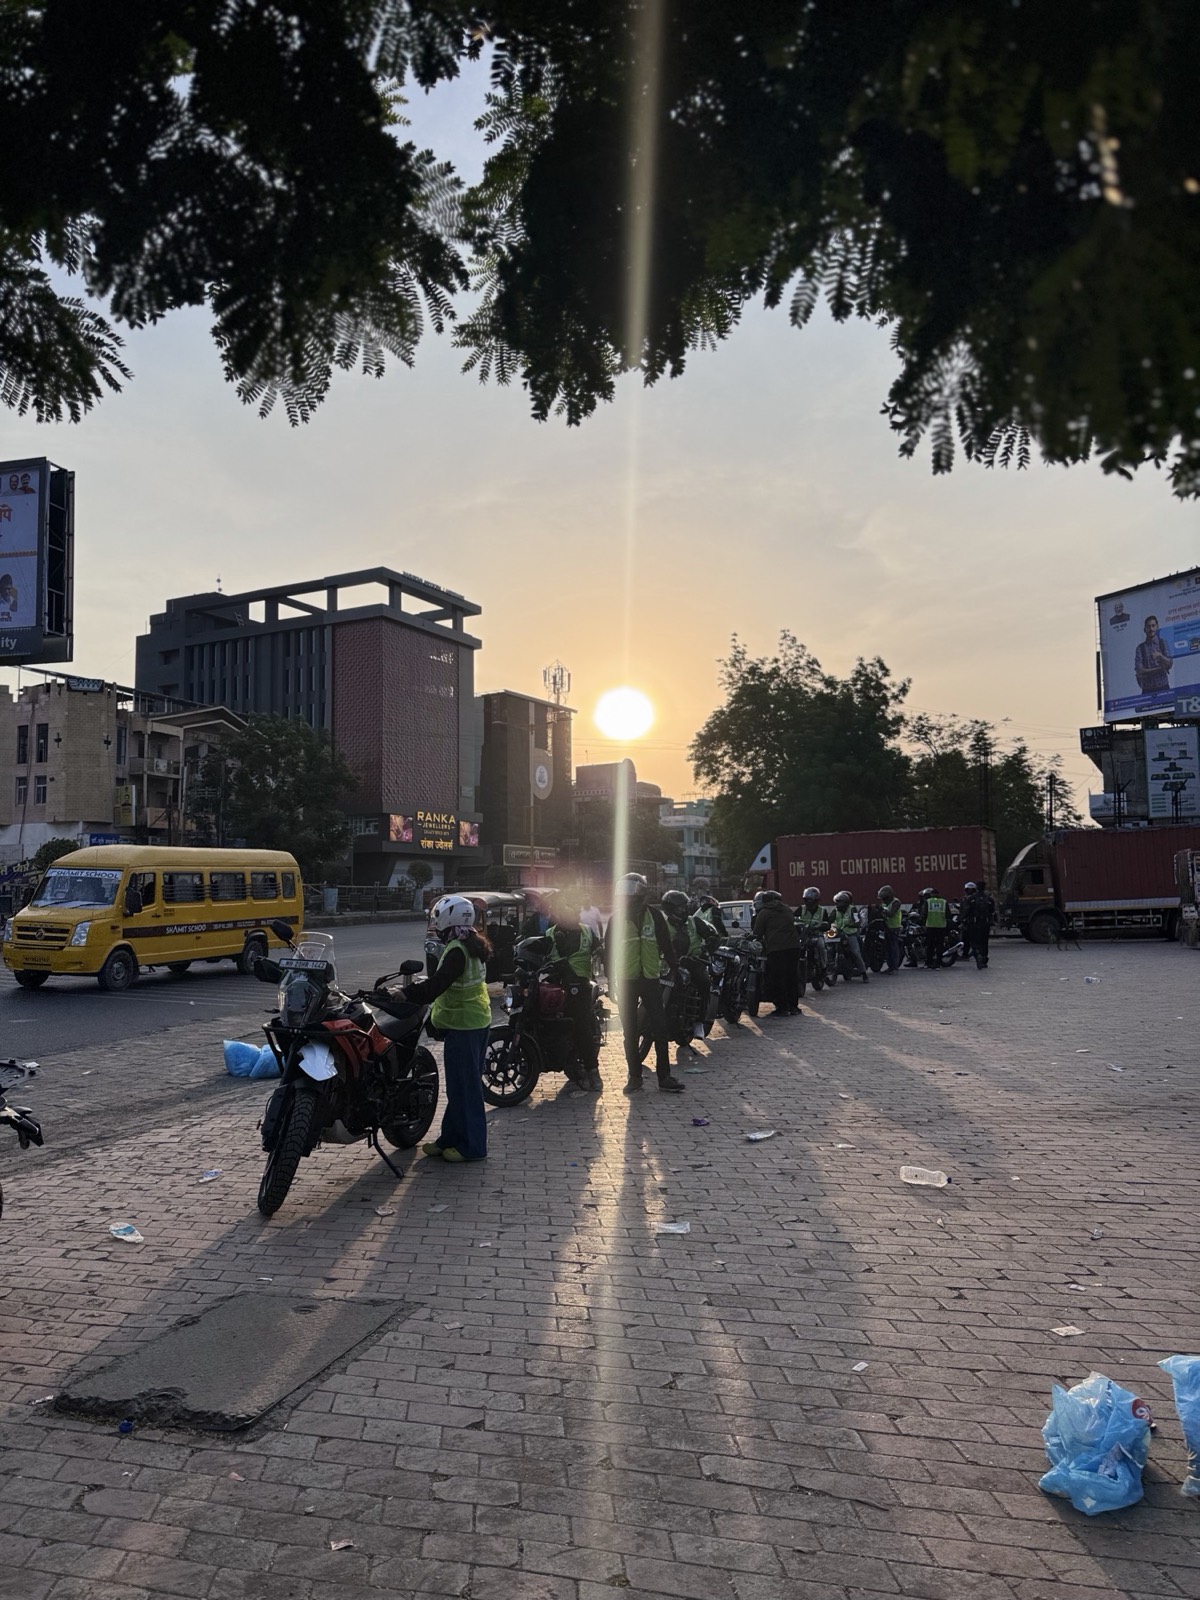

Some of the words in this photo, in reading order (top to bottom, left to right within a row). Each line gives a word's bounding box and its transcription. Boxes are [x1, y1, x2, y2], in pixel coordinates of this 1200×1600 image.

[417, 811, 456, 824] RANKA
[789, 861, 805, 877] OM
[811, 860, 829, 876] SAI
[840, 856, 906, 876] CONTAINER
[914, 853, 968, 872] SERVICE
[165, 924, 188, 935] SHAMIT
